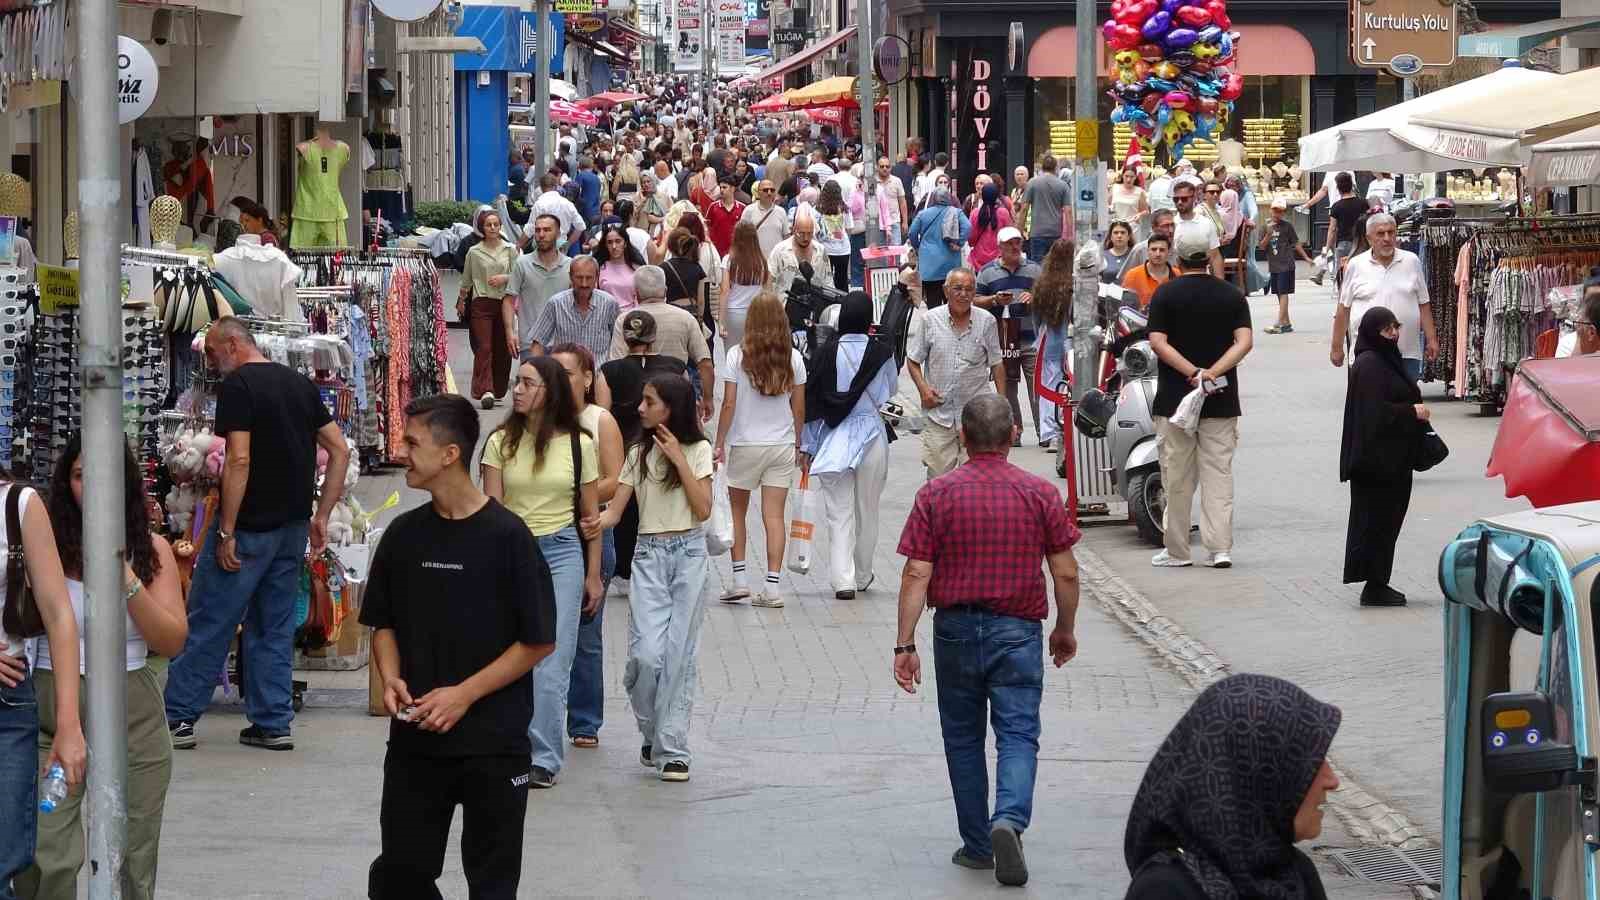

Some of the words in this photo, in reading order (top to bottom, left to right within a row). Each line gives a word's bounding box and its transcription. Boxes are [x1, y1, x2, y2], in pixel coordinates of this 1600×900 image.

[1364, 12, 1420, 33] Kurtuluş
[1422, 14, 1449, 31] Yolu
[973, 59, 991, 171] DÖVİ
